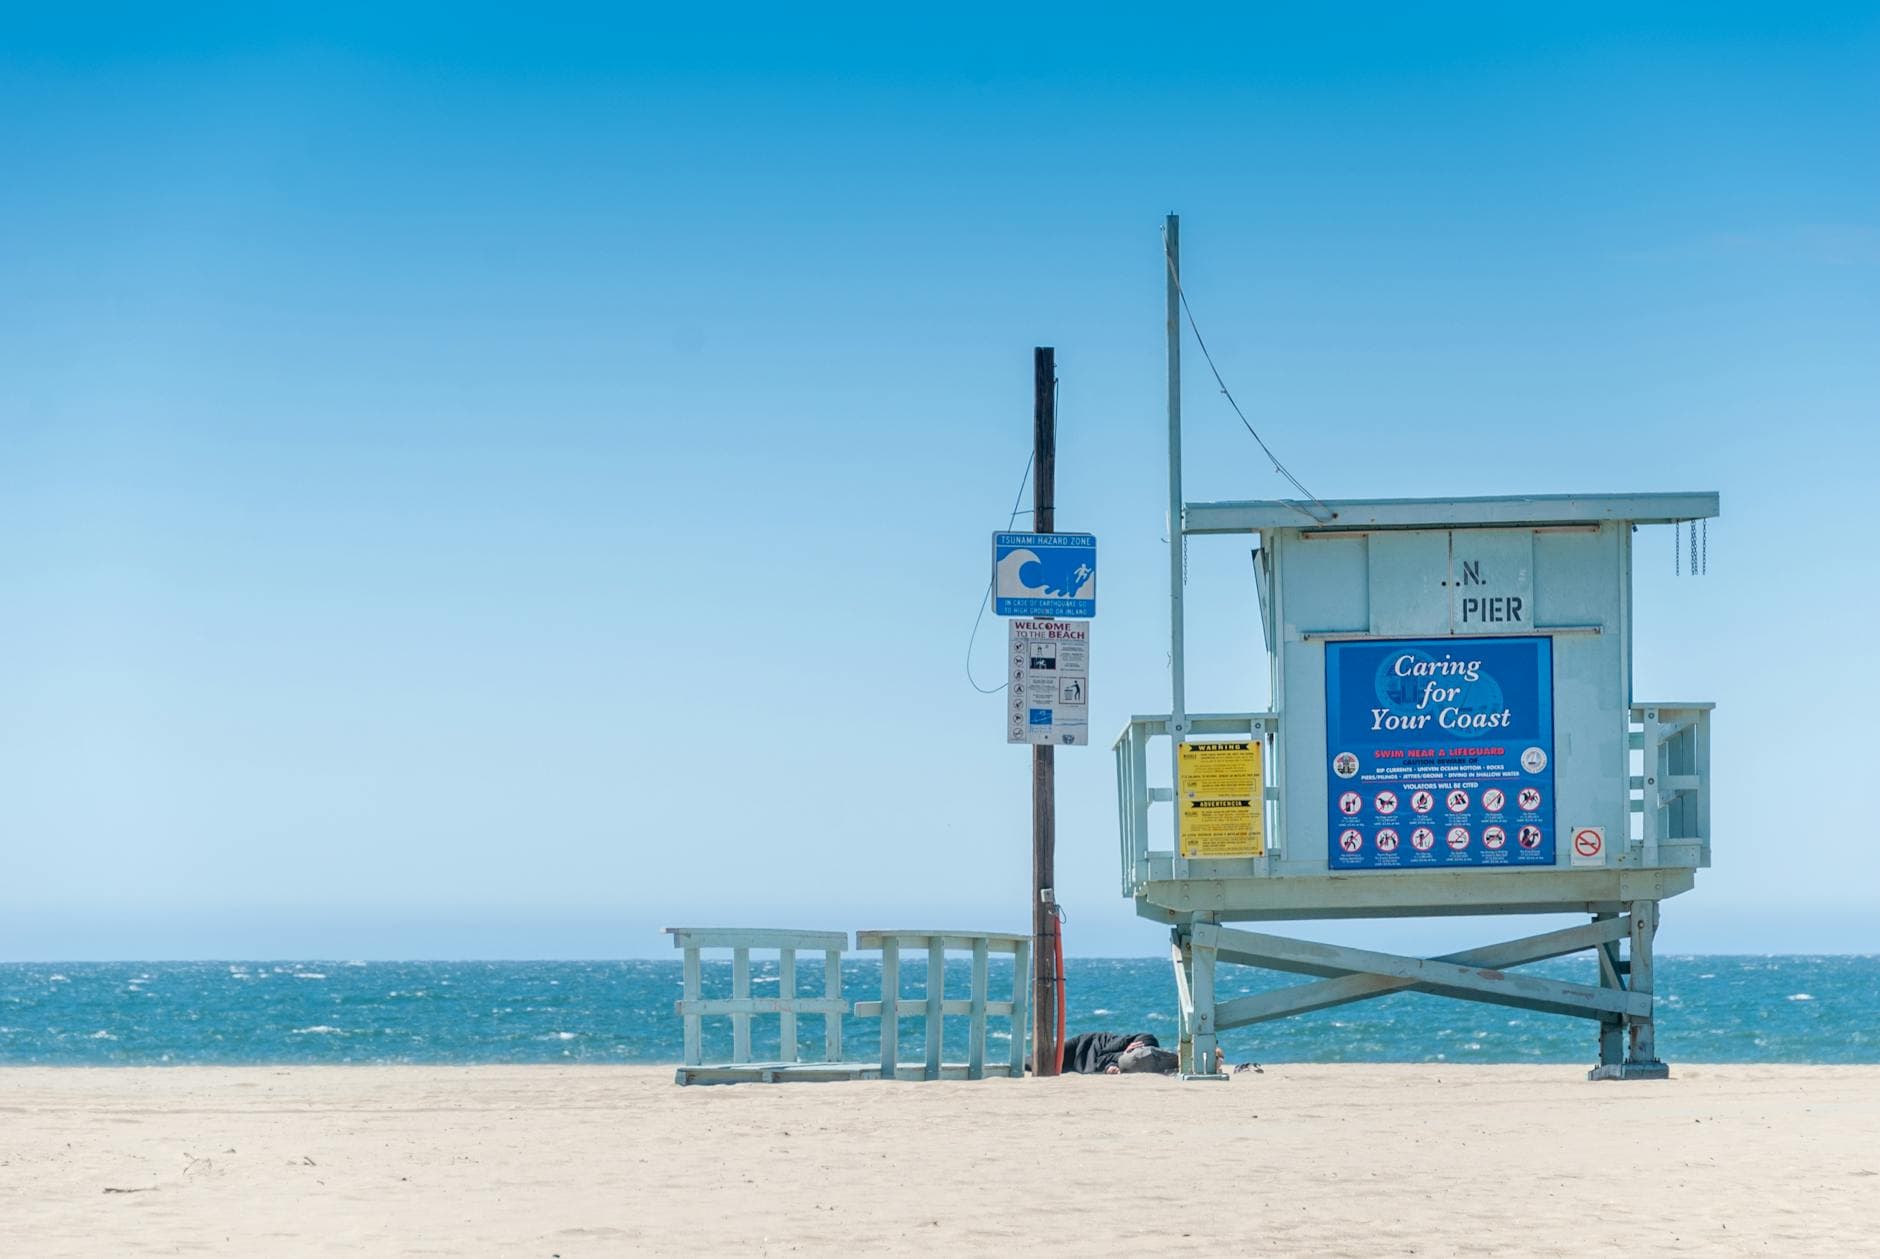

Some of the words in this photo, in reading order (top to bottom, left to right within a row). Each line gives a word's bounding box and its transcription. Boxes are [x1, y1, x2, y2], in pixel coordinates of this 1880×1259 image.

[1002, 536, 1035, 544] TSUNAMI
[1463, 597, 1522, 622] PIER
[1015, 622, 1071, 631] WELCOME
[1048, 631, 1084, 639] BEACH
[1394, 654, 1481, 682] Caring
[1416, 682, 1460, 709] for
[1371, 708, 1430, 730] Your
[1439, 707, 1511, 729] Coast
[1375, 750, 1404, 758] SWIM
[1408, 749, 1434, 758] NEAR
[1449, 747, 1504, 756] LIFEGUARD
